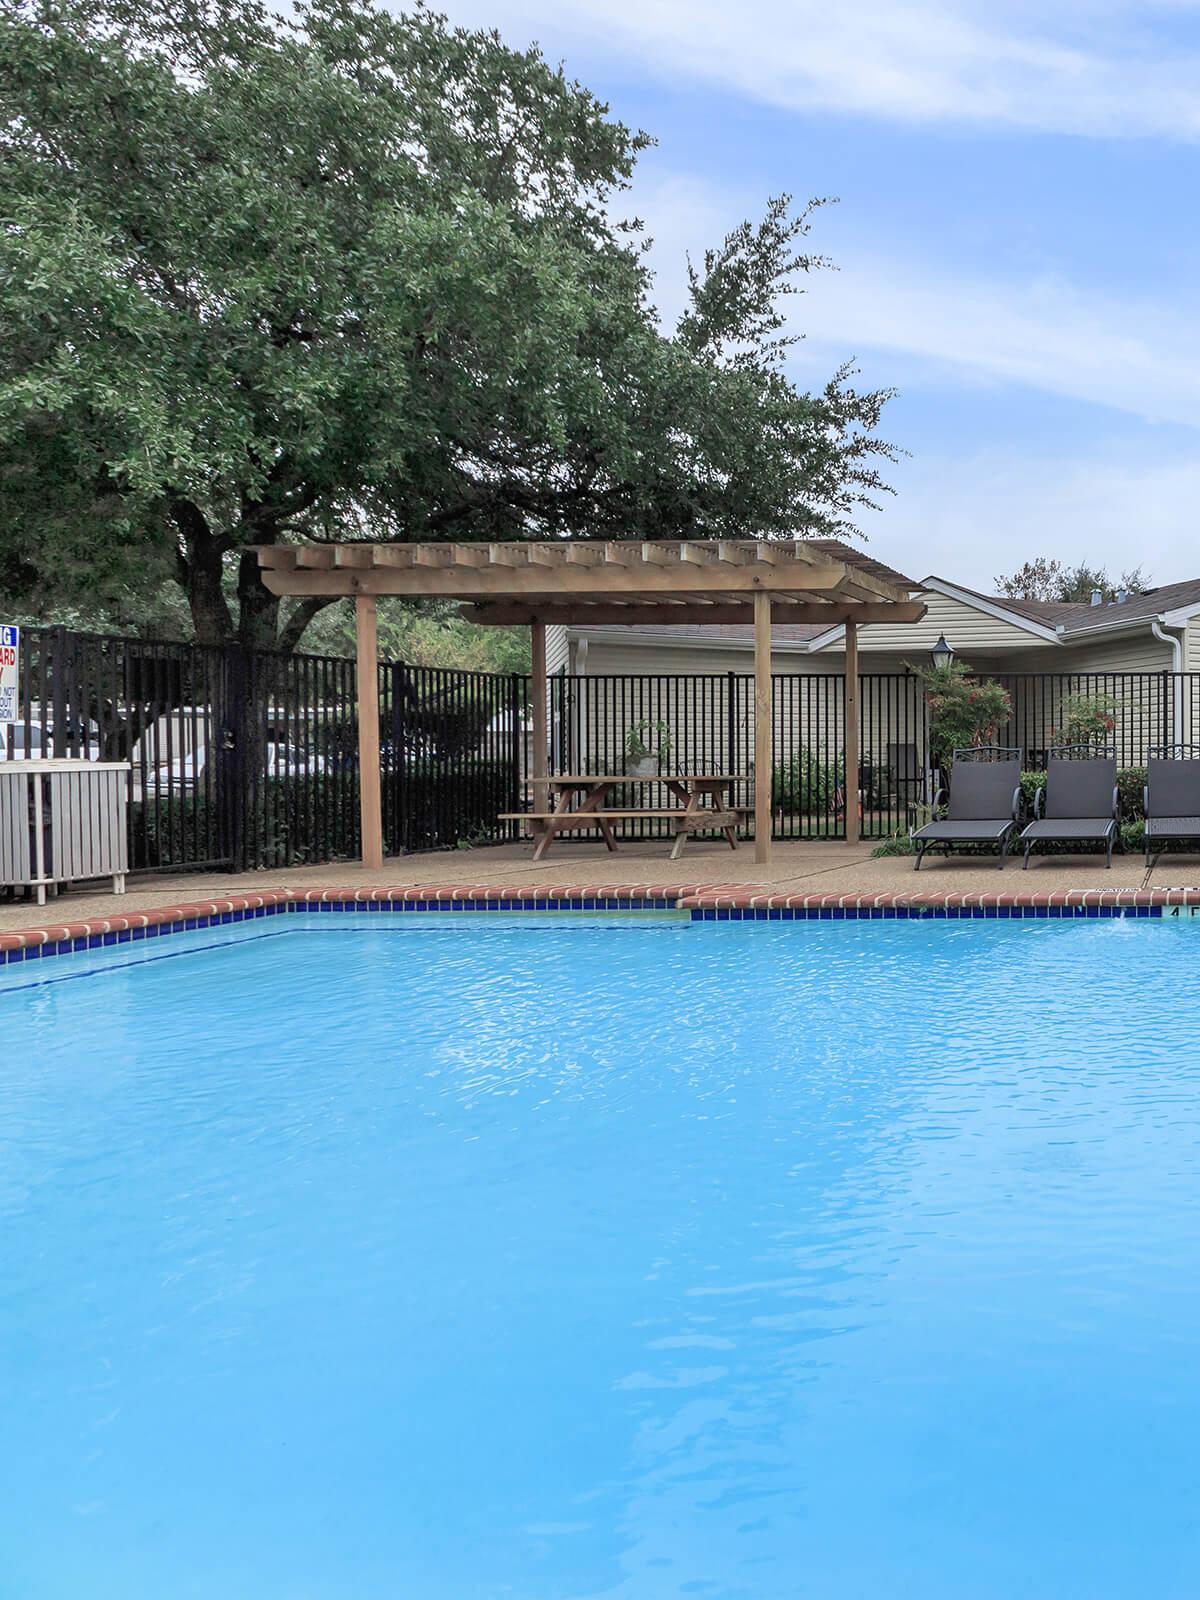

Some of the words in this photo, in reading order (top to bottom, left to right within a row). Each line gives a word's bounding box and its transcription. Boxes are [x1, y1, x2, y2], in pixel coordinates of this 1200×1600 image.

[0, 626, 12, 645] G
[4, 687, 16, 697] NOT
[1170, 906, 1179, 917] 4
